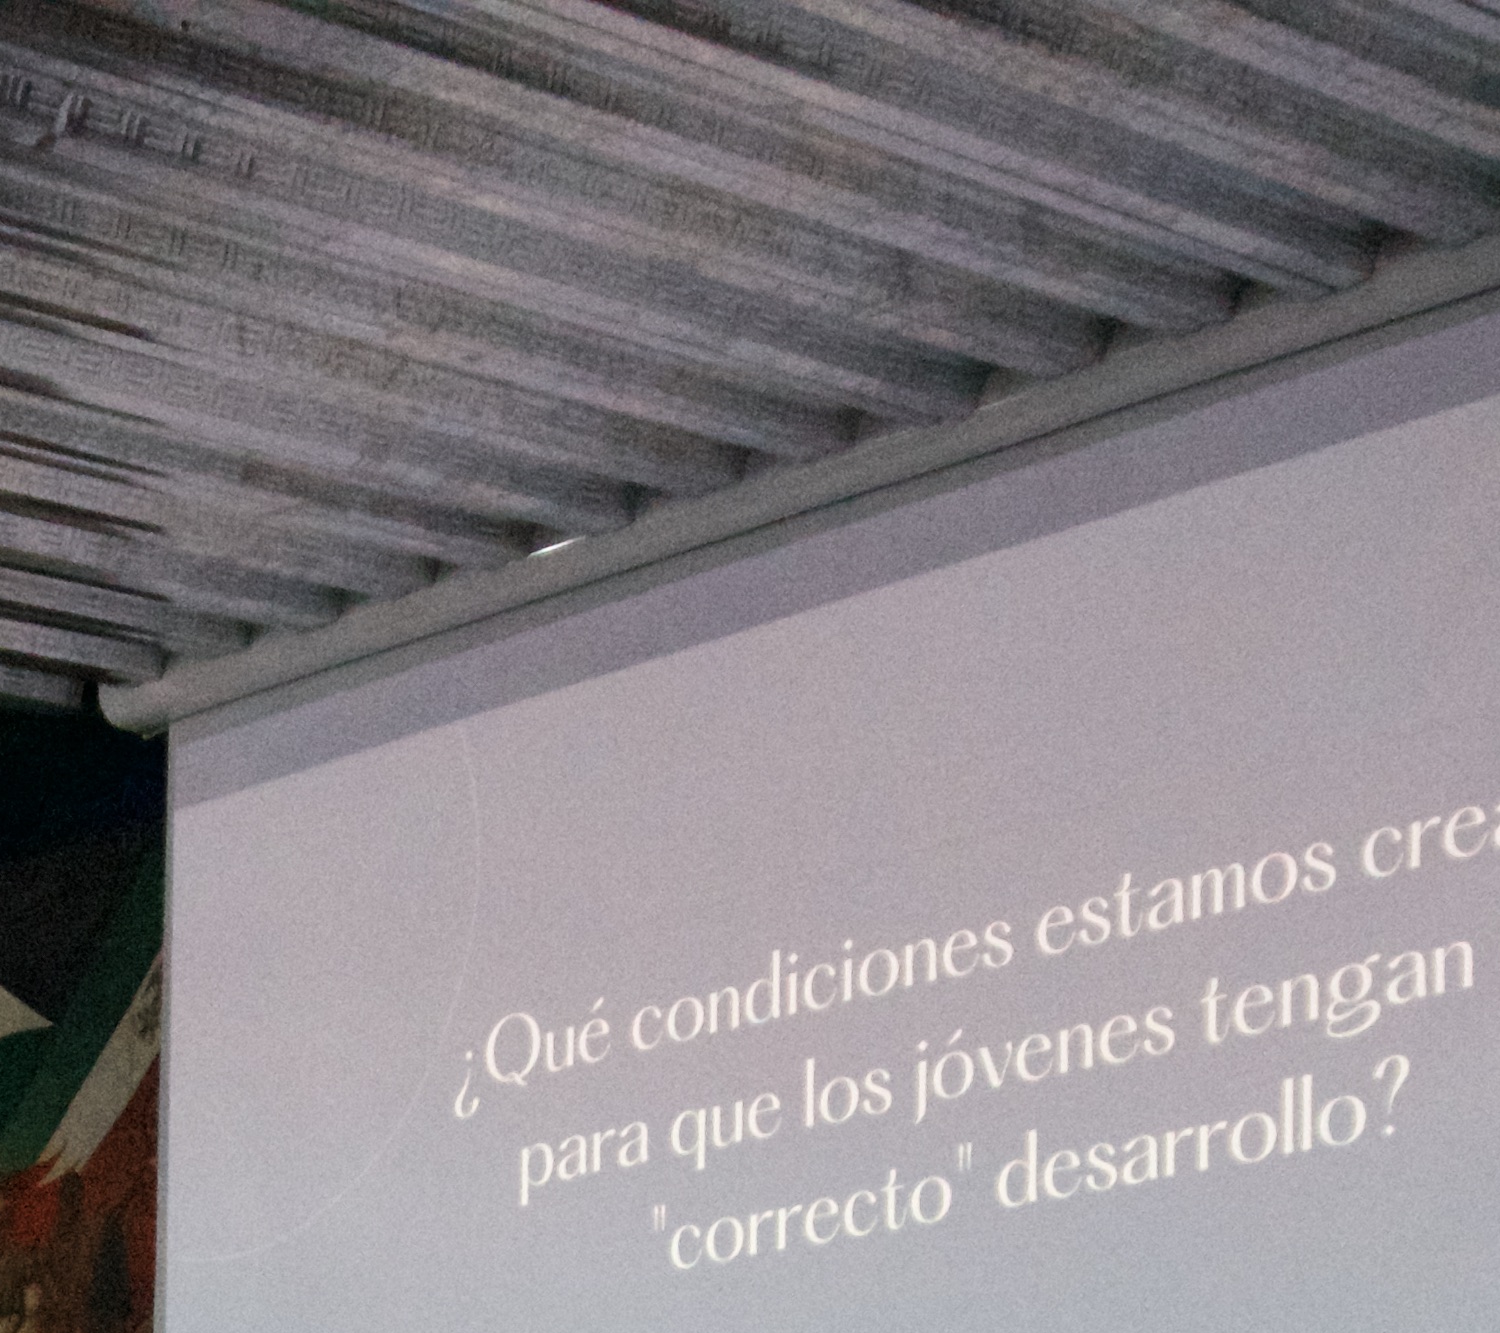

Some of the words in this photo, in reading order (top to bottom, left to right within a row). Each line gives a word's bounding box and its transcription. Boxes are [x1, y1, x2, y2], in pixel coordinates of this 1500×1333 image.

[452, 997, 612, 1118] ¿Qué
[631, 918, 1014, 1050] condiciones
[1035, 841, 1338, 956] estamos
[518, 1120, 650, 1205] para
[669, 1091, 783, 1169] que
[803, 1057, 894, 1128] los
[912, 1005, 1176, 1124] jóvenes
[1199, 940, 1475, 1038] tengan
[652, 1141, 973, 1269] "correcto"
[996, 1053, 1411, 1208] desarrollo?
